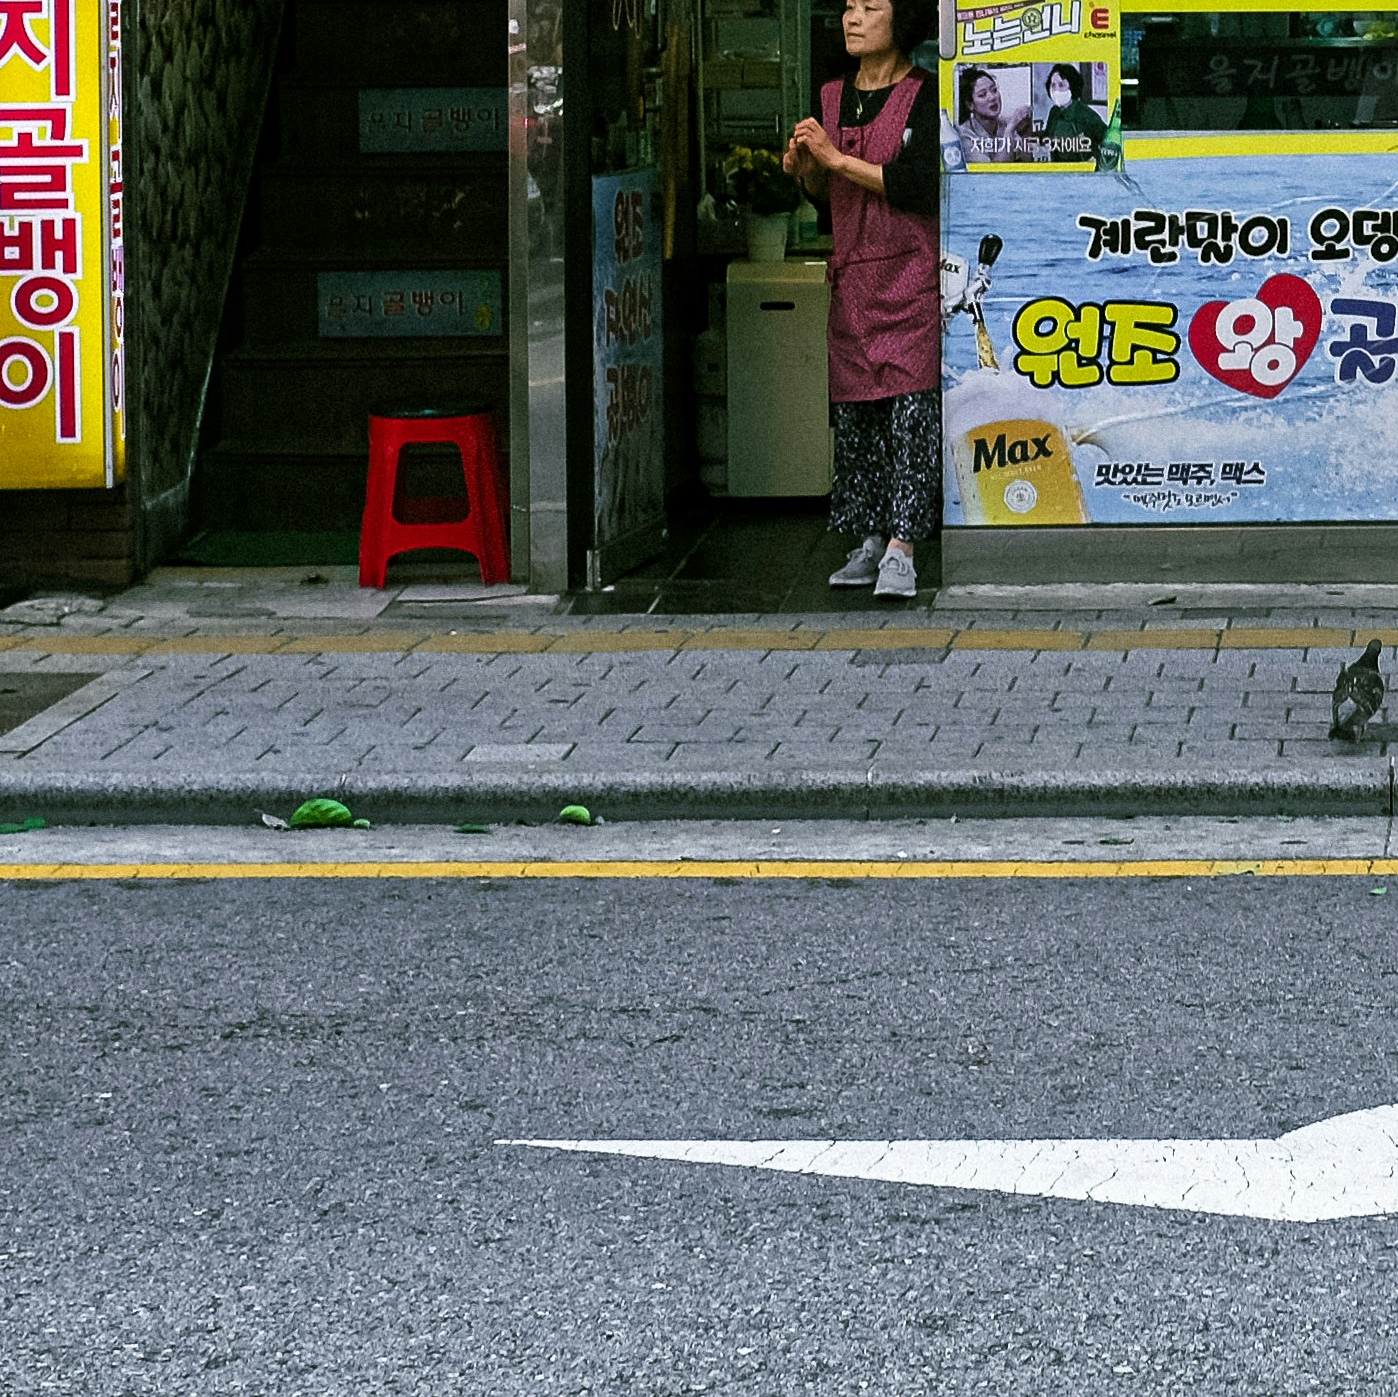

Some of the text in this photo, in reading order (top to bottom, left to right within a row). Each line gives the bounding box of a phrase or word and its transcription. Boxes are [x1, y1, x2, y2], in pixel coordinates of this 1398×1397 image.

[1077, 206, 1294, 265] 계란말이
[1012, 295, 1182, 390] 원조
[1214, 297, 1305, 388] 왕
[970, 433, 1055, 474] Max
[1095, 462, 1267, 487] 맛있는 맥주, 맥스
